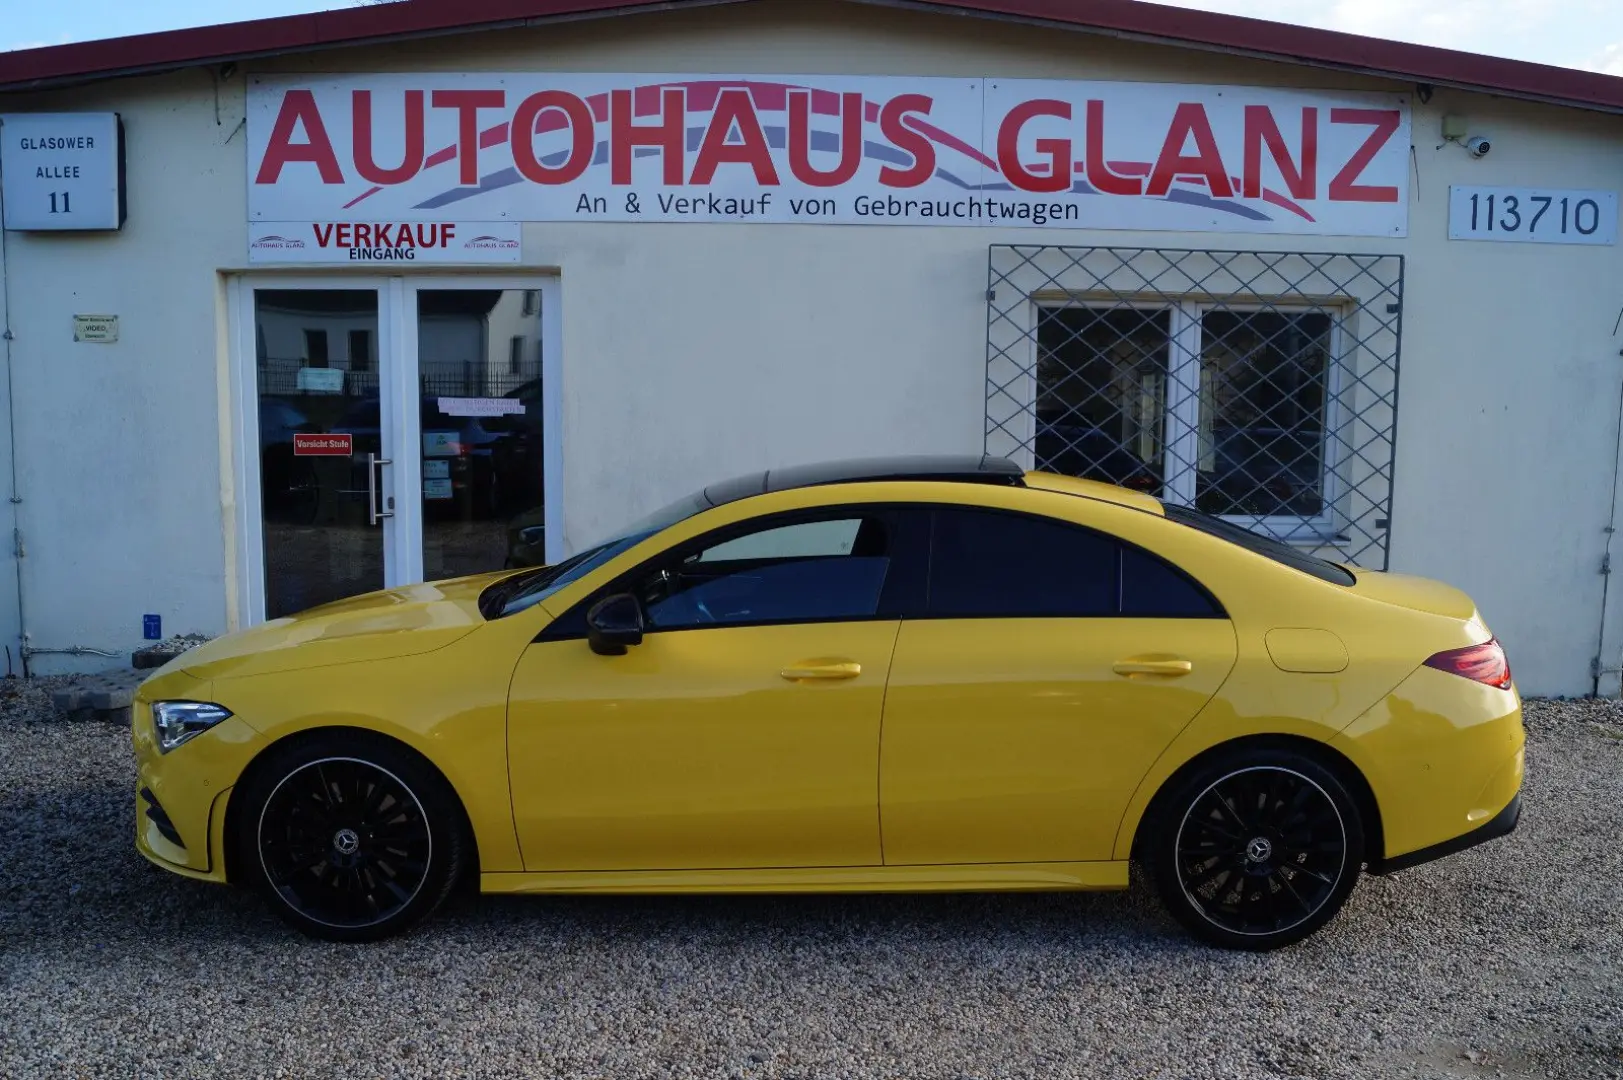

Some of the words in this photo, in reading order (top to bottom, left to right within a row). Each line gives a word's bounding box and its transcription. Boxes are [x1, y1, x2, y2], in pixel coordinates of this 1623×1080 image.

[20, 137, 94, 150] GLASOWER
[255, 89, 937, 188] AUTOHAUS
[997, 98, 1401, 203] GLANZ
[36, 166, 80, 179] ALLEE
[48, 191, 72, 213] 11
[575, 193, 607, 214] An
[625, 193, 642, 214] &
[657, 193, 772, 215] Verkauf
[791, 199, 836, 216] von
[854, 195, 1079, 223] Gebrauchtwagen
[1470, 193, 1600, 235] 113710
[312, 223, 456, 248] VERKAUF
[349, 247, 415, 261] EINGANG
[85, 323, 106, 332] VIDEO
[296, 438, 328, 448] Vorsicht
[329, 438, 349, 448] Stufe
